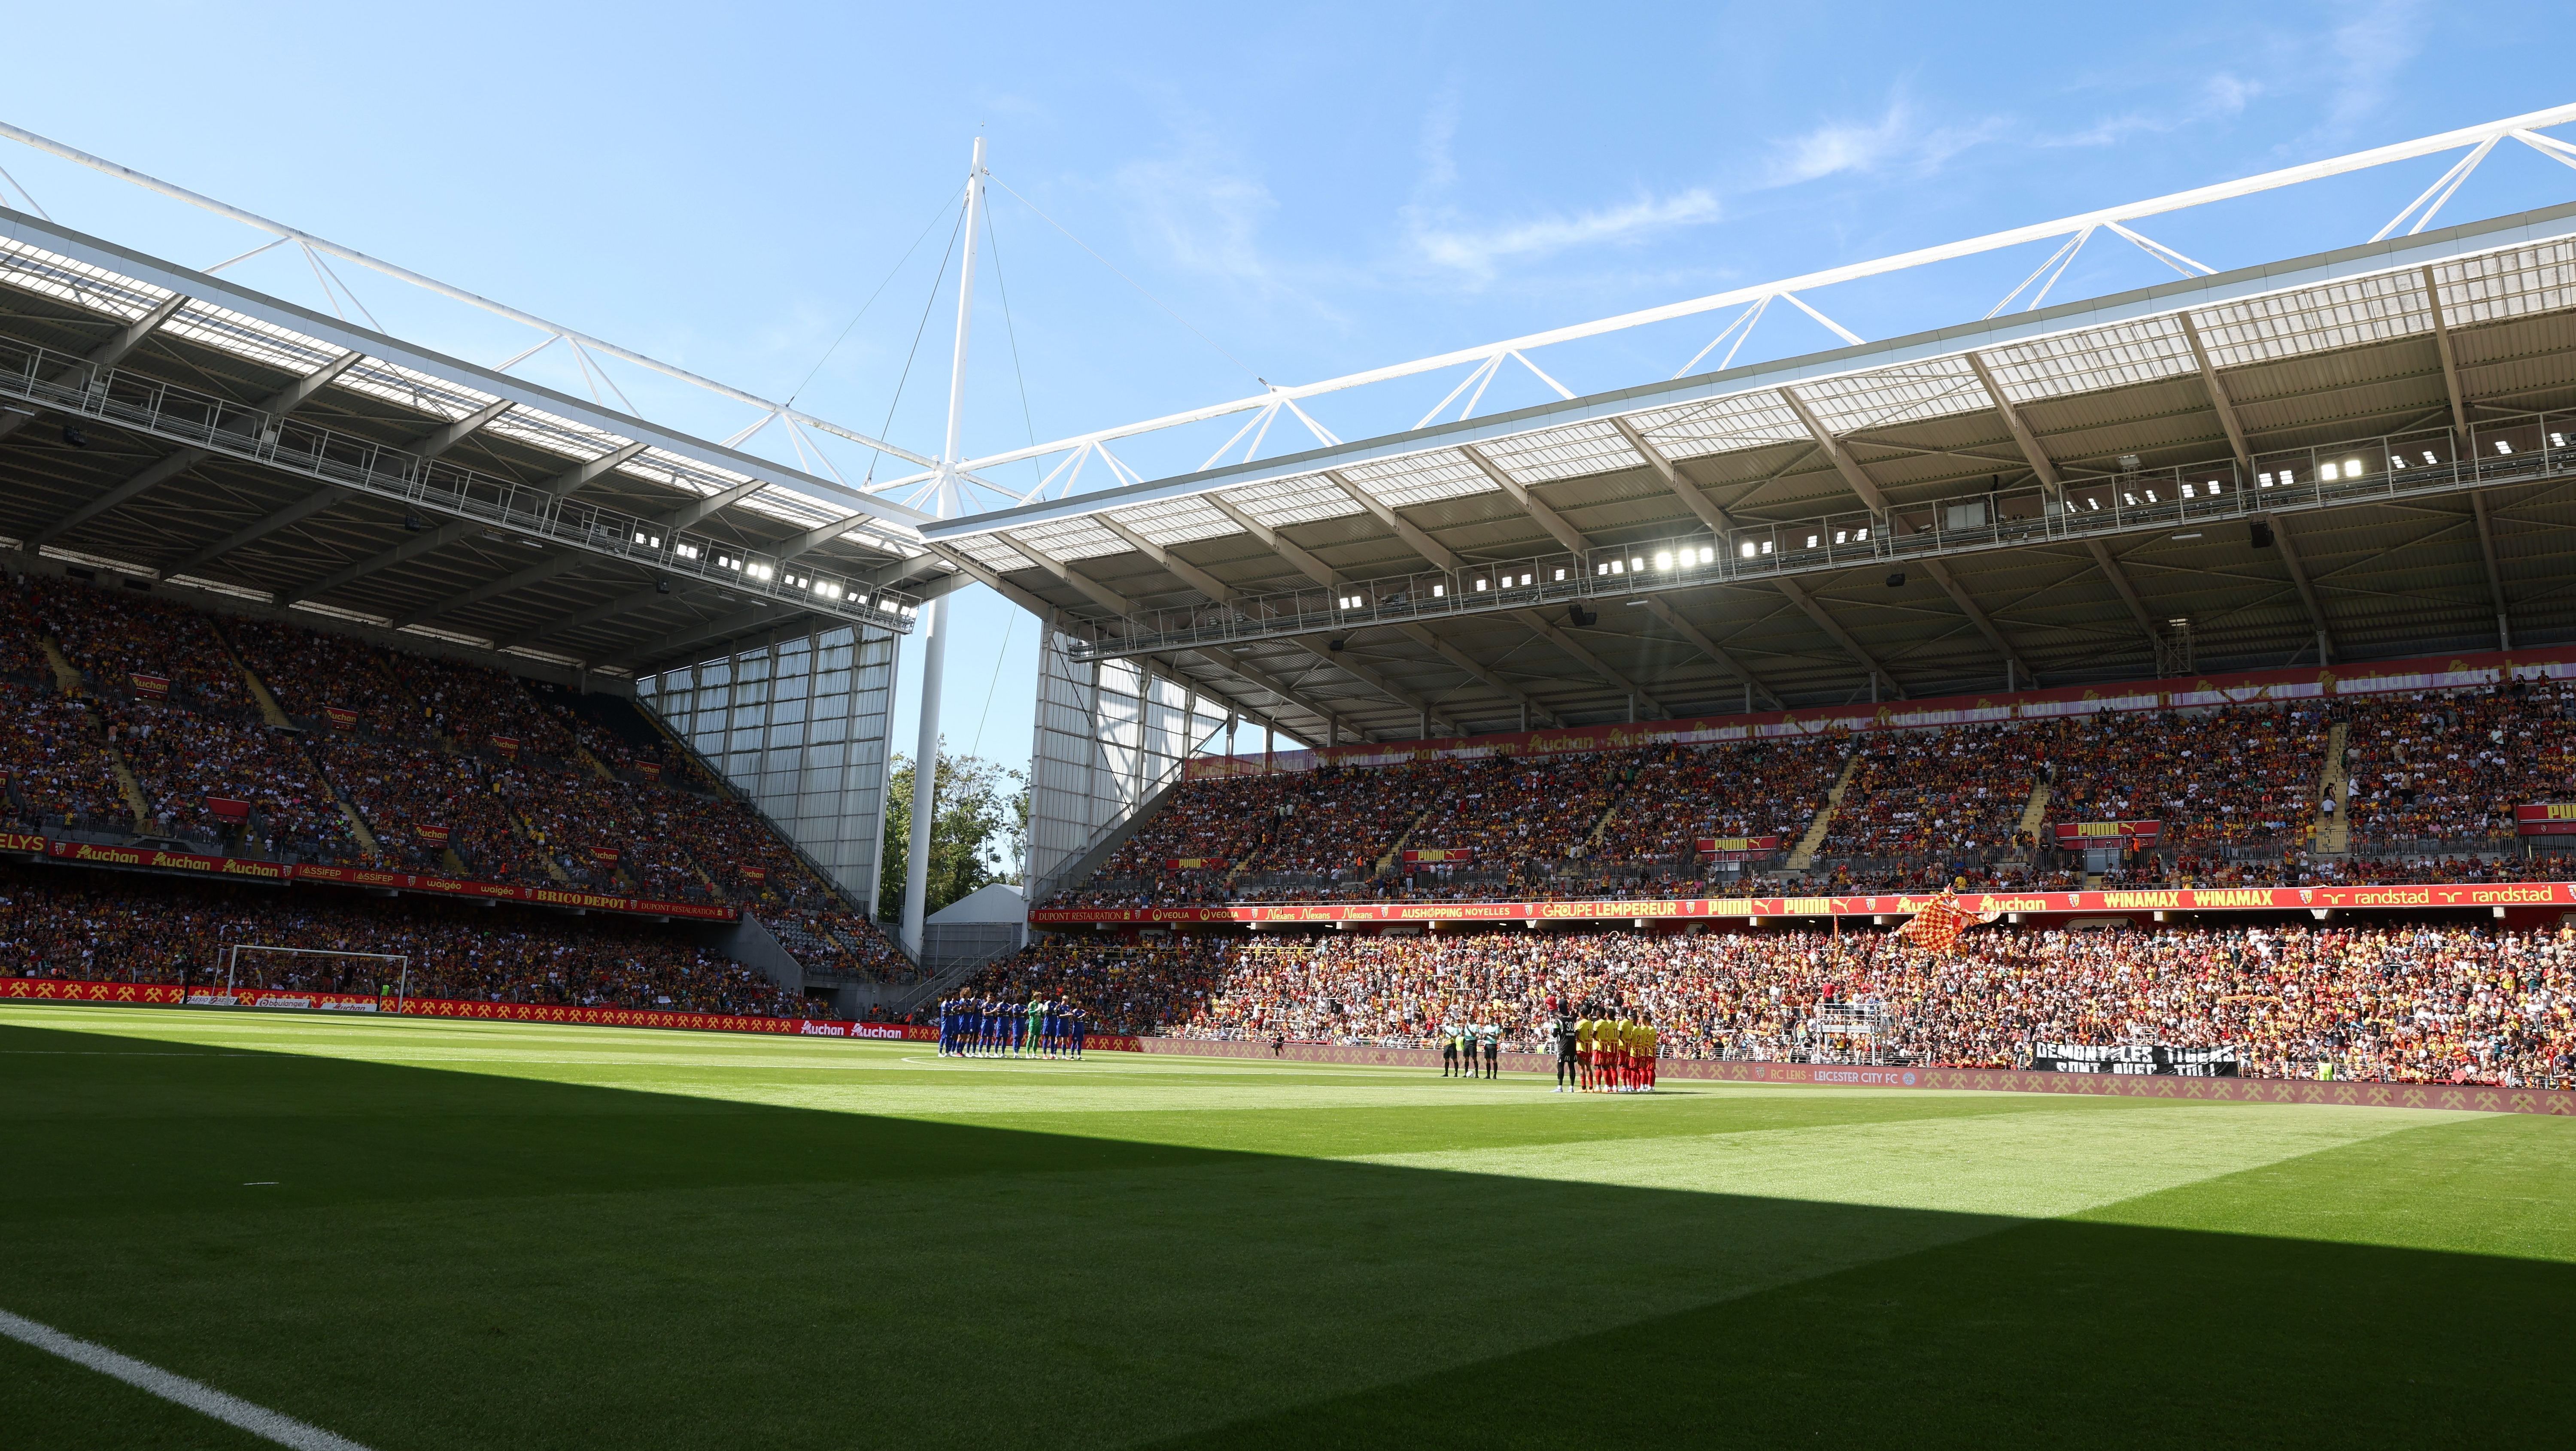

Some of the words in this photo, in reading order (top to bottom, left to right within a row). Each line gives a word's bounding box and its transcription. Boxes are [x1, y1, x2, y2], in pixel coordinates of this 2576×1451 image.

[132, 677, 168, 691] Auchan
[327, 710, 356, 722] Auchan
[1527, 735, 1594, 752] Auchan
[1607, 728, 1676, 747] Auchan
[1189, 761, 1240, 777] Auchan
[2547, 805, 2576, 819] PU
[416, 826, 447, 839] Auchan
[2078, 823, 2118, 836] PUMA
[1715, 838, 1747, 850] PUMA
[76, 844, 139, 864] Auchan
[152, 851, 211, 871] Auchan
[1418, 850, 1444, 860] PUMA
[222, 859, 278, 877] Auchan
[1179, 859, 1201, 868] PUMA
[427, 880, 462, 890] waigéo
[481, 886, 514, 895] waigéo
[537, 890, 581, 904] BRICO
[583, 895, 626, 909] DEPOT
[2104, 891, 2179, 908] WINAMAX
[2193, 890, 2273, 907] WINAMAX
[2354, 888, 2429, 905] randstad
[2472, 886, 2552, 903] randstad
[641, 903, 671, 911] DUPONT
[672, 906, 715, 915] RESTAURATION
[1543, 904, 1592, 917] GROUPE
[1596, 902, 1676, 916] LEMPEREUR
[1708, 900, 1752, 915] PUMA
[1784, 899, 1830, 914] PUMA
[1979, 895, 2046, 911] Auchan
[1039, 912, 1070, 920] DUPONT
[1072, 912, 1121, 920] RESTAURATION
[1265, 908, 1295, 920] Nexans
[1300, 908, 1330, 920] Nexans
[1341, 907, 1373, 920] Nexans
[1465, 908, 1510, 916] NOYELLES
[801, 1020, 844, 1035] Auchan
[851, 1023, 901, 1038] Auchan
[1565, 1021, 1574, 1031] 30
[2120, 1046, 2153, 1063] LES
[2164, 1045, 2235, 1063] TIGERS
[1771, 1069, 1784, 1079] RC
[1786, 1070, 1806, 1080] LENS
[1814, 1071, 1859, 1082] LEICESTER
[1861, 1072, 1883, 1084] CITY
[1886, 1073, 1899, 1084] FC
